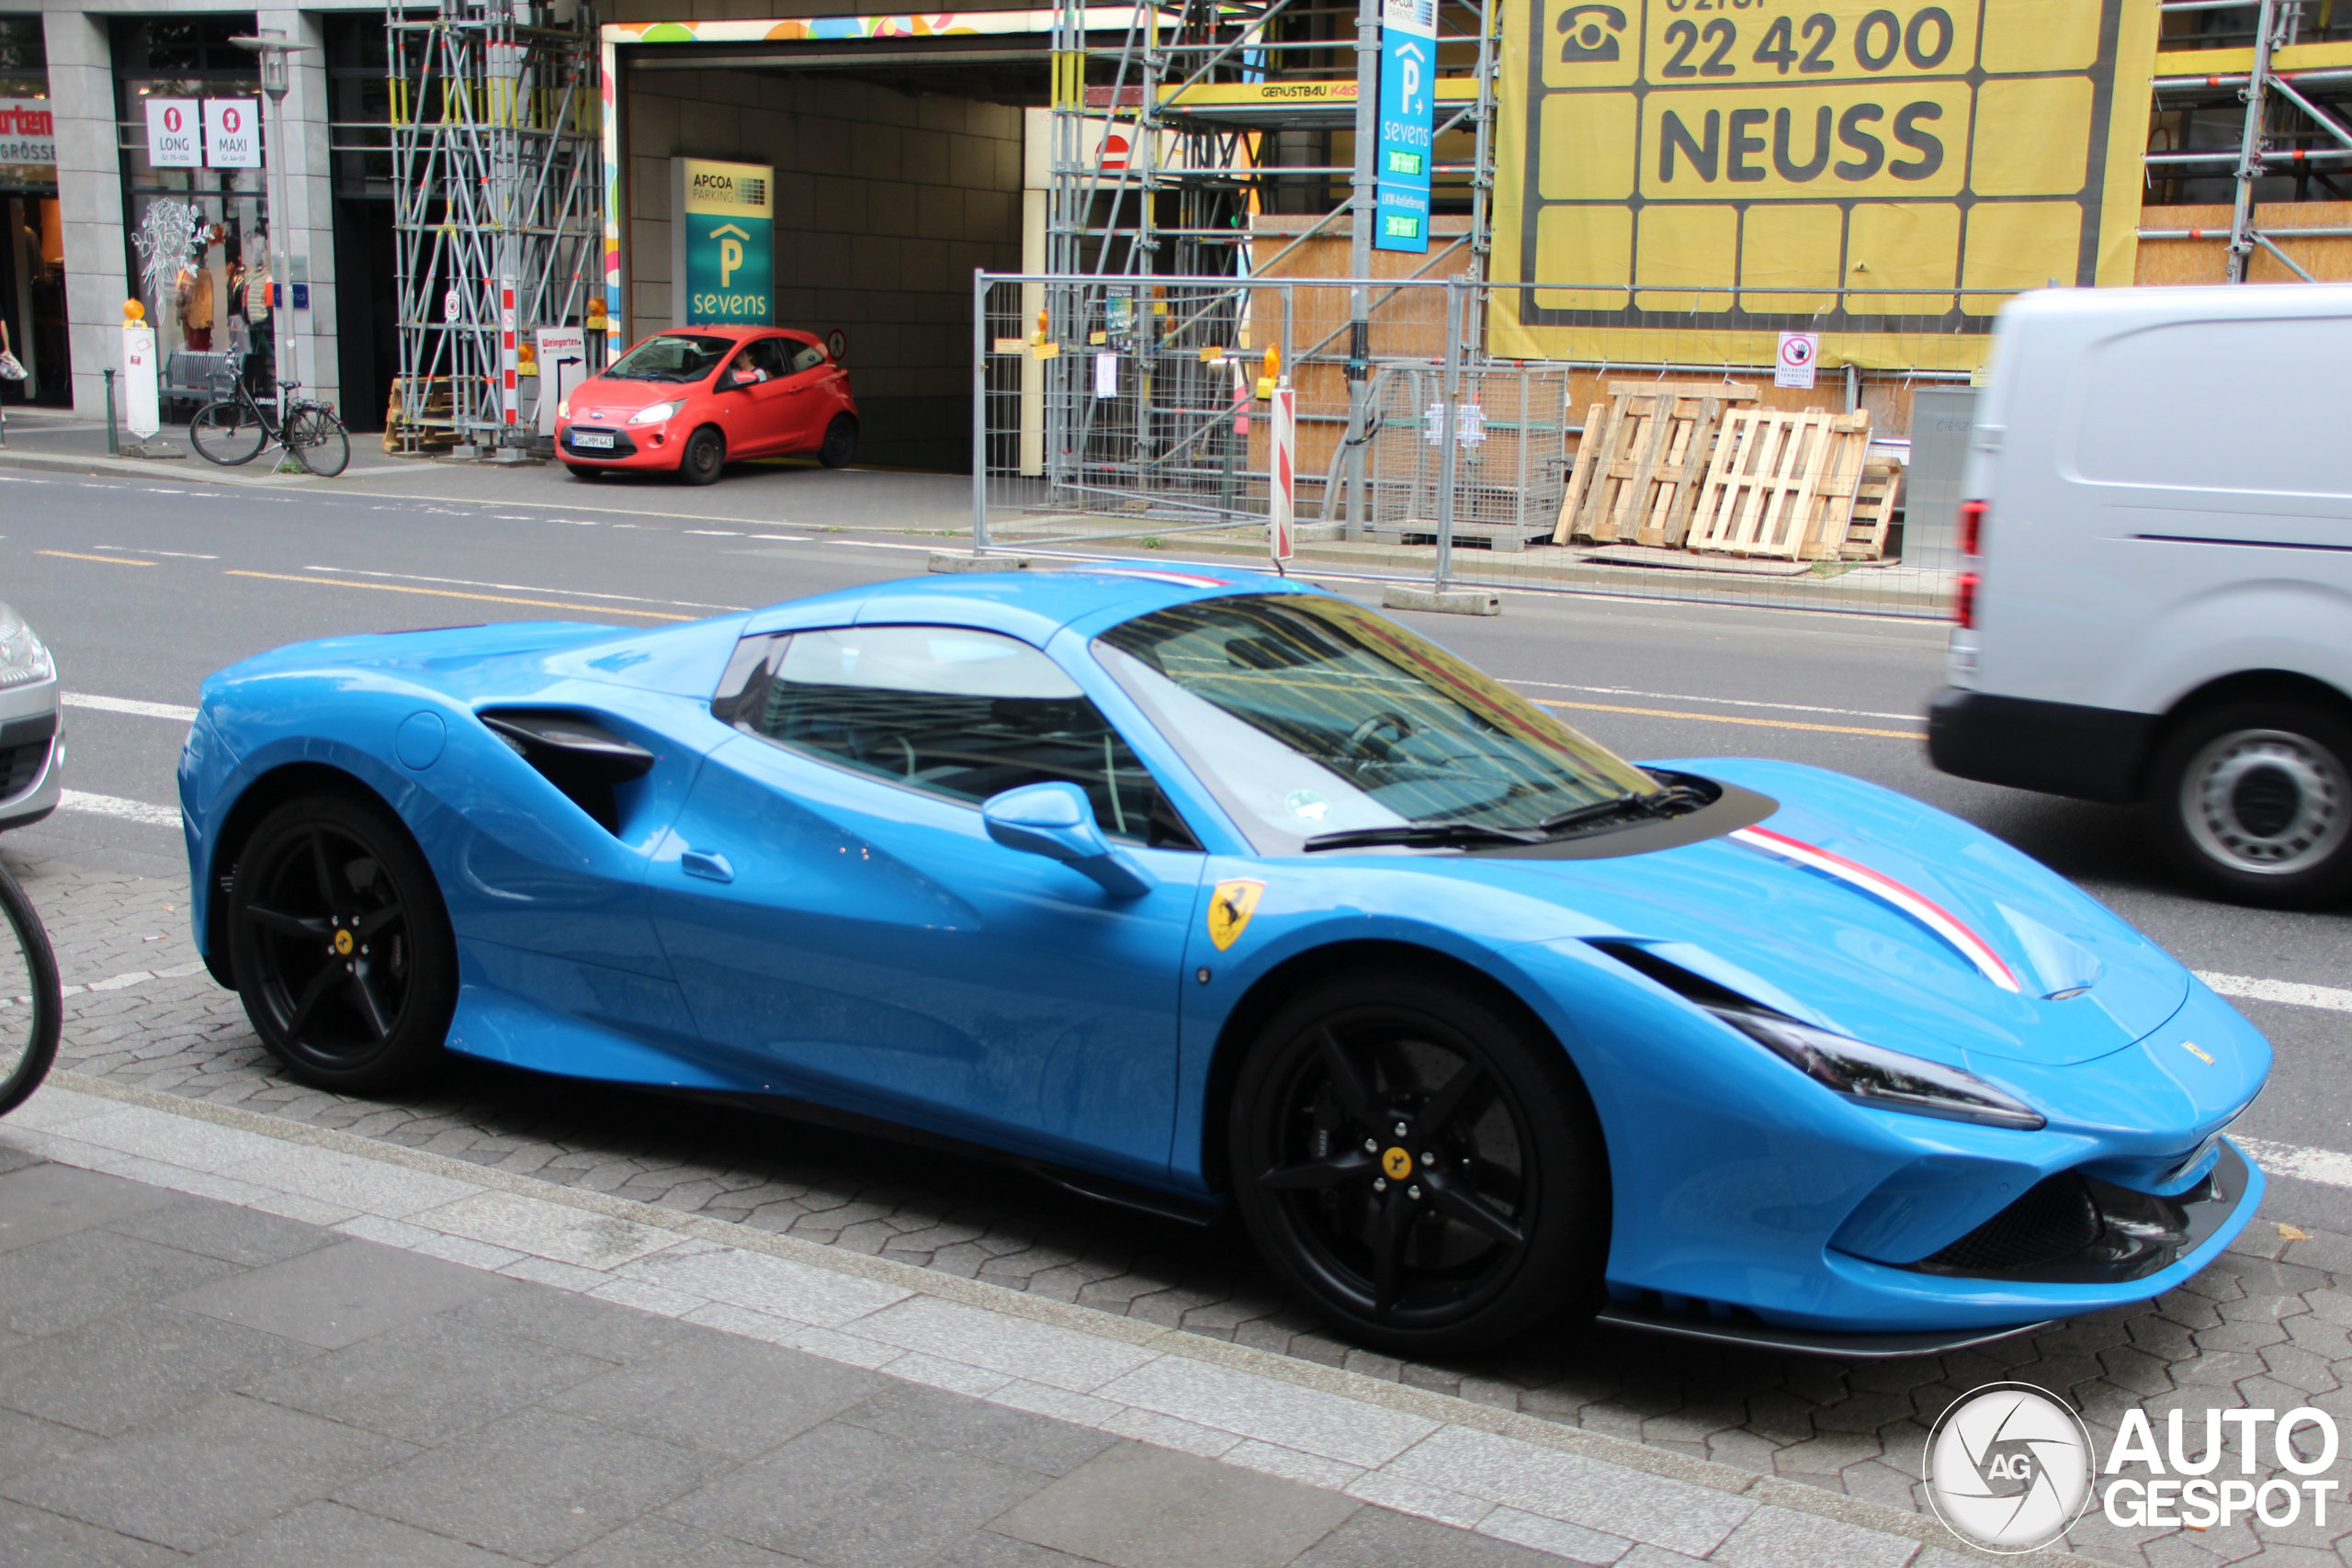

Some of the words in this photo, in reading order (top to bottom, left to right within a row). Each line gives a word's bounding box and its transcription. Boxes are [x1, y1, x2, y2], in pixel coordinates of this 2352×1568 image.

[1388, 6, 1414, 23] PARKING
[1661, 17, 1736, 78] 22
[1751, 13, 1837, 75] 42
[1853, 6, 1954, 73] 00
[1402, 58, 1419, 114] P
[0, 105, 53, 136] rten
[160, 137, 189, 152] LONG
[1384, 120, 1429, 147] sevens
[1658, 101, 1944, 184] NEUSS
[219, 138, 248, 152] MAXI
[694, 174, 733, 190] APCOA
[693, 188, 734, 203] PARKING
[1382, 192, 1426, 213] LKW-Anlieferung
[720, 238, 743, 288] P
[694, 293, 766, 315] sevens
